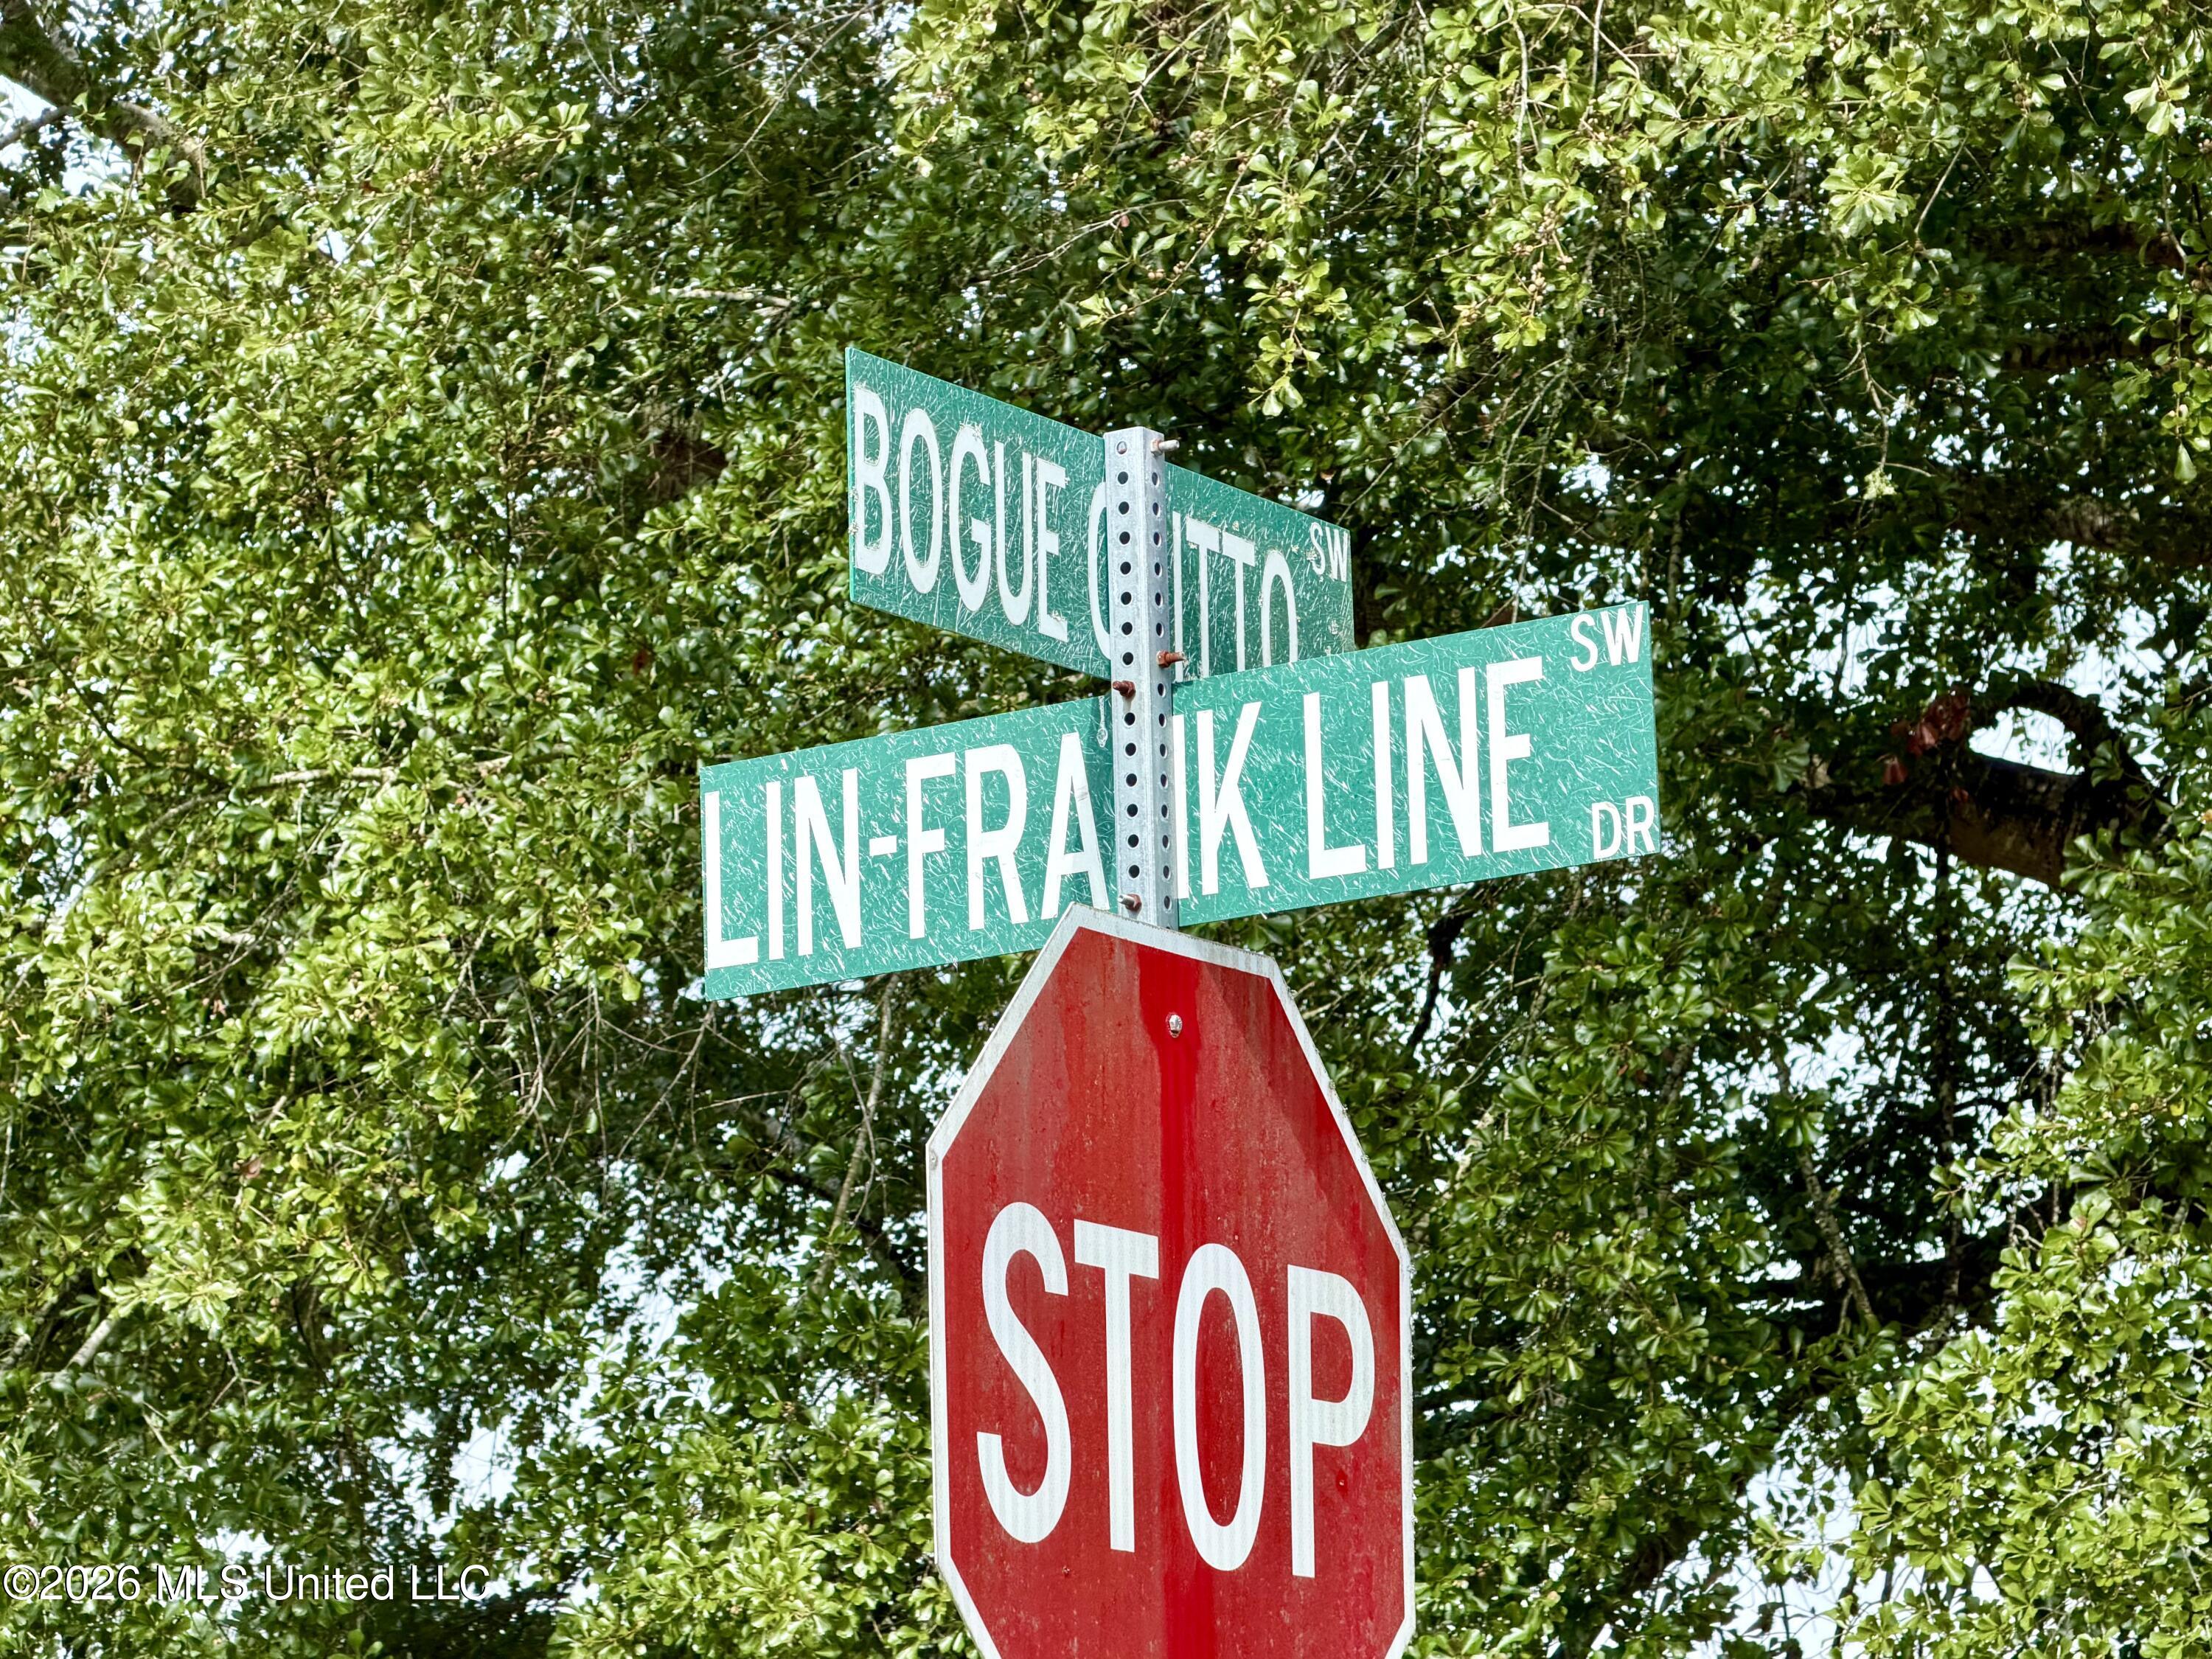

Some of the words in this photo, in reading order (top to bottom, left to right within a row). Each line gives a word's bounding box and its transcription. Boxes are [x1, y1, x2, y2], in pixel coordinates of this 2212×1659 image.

[854, 382, 1068, 643] BOGUE
[1310, 521, 1350, 582] SW
[1570, 604, 1644, 672] SW
[704, 702, 1270, 970] LIN-FRAK
[1303, 655, 1550, 880] LINE
[1592, 795, 1657, 860] DR
[976, 1201, 1376, 1579] STOP
